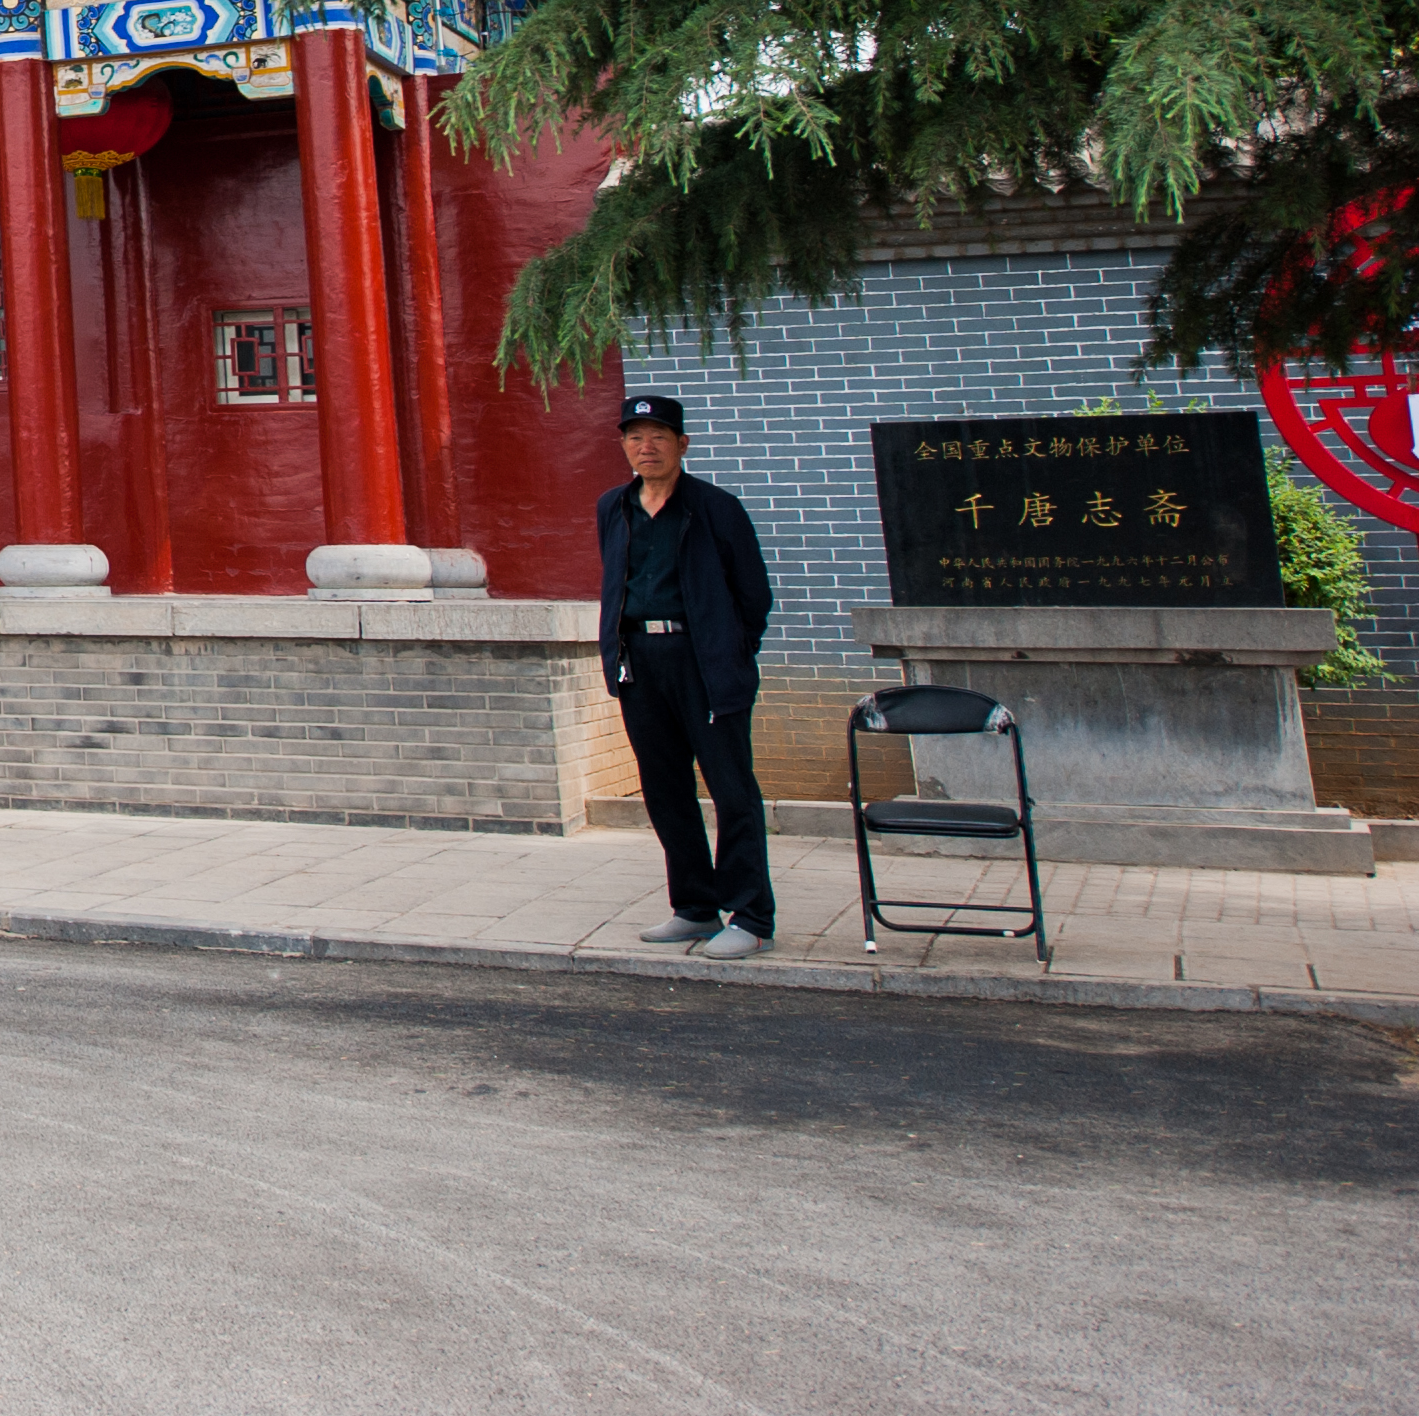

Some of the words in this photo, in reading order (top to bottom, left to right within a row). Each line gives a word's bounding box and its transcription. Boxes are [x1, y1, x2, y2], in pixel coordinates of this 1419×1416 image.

[914, 434, 1190, 461] 全国重点文物保护单位
[954, 489, 1188, 529] 千唐志斋
